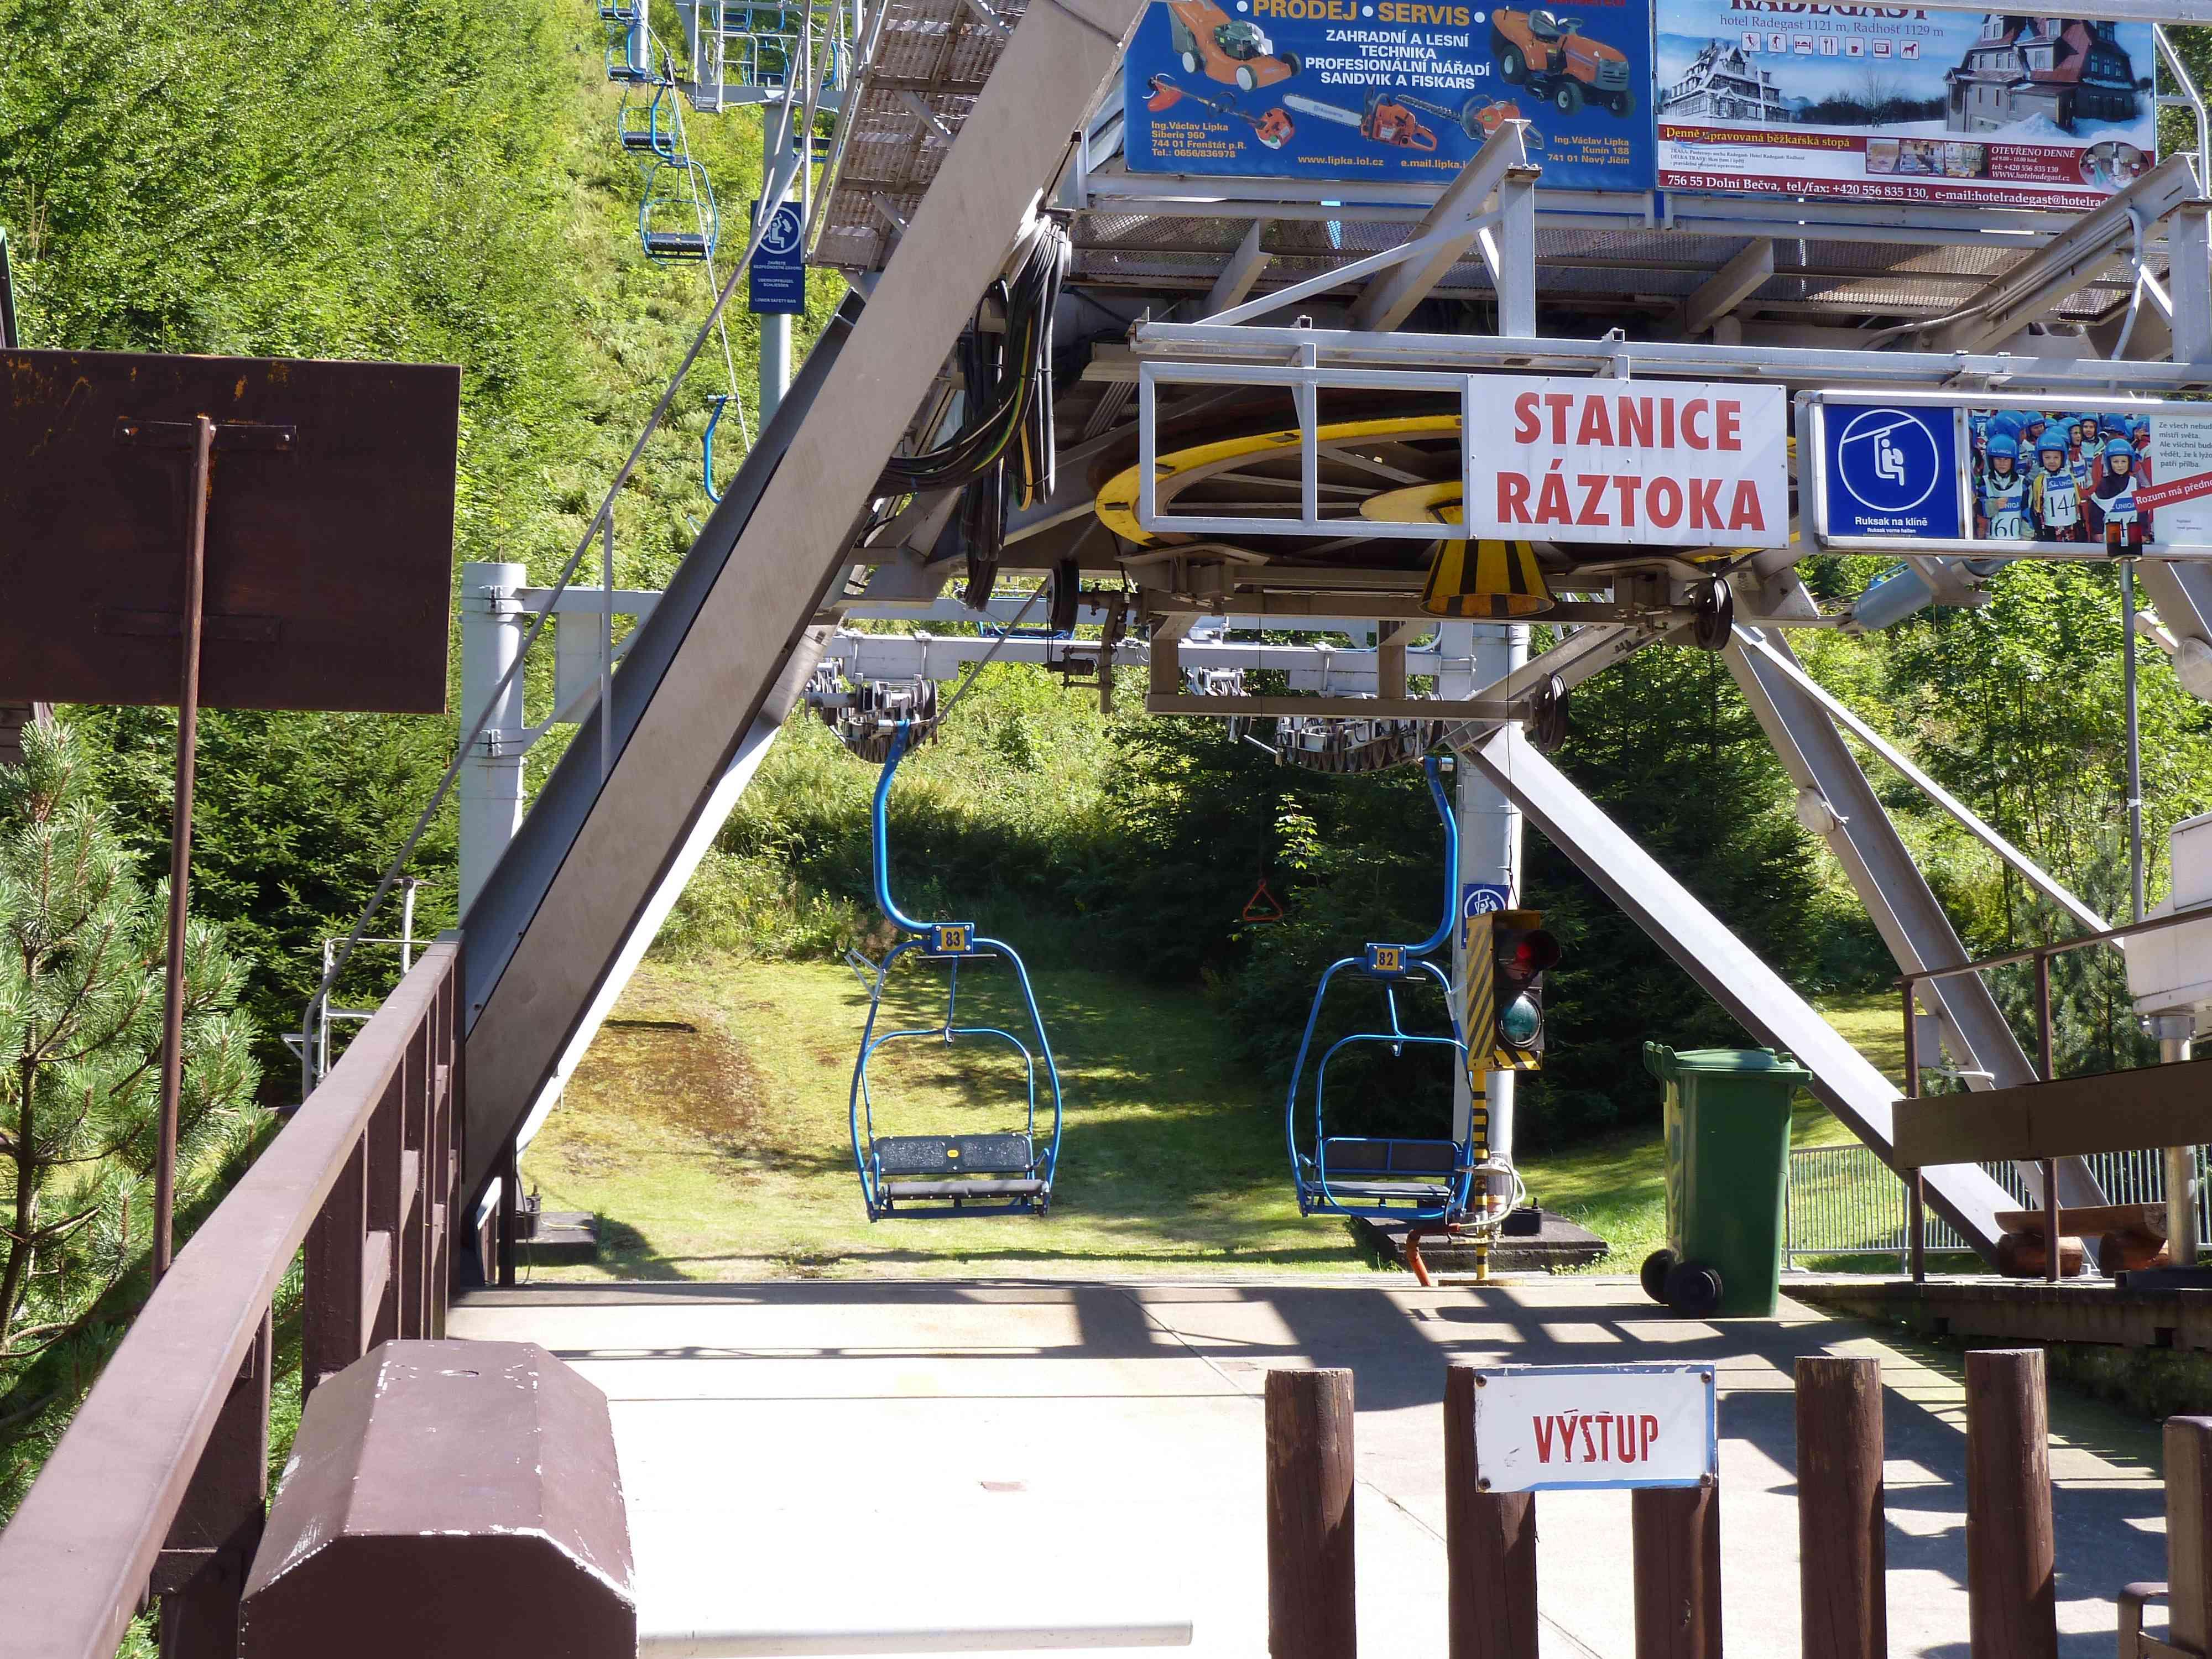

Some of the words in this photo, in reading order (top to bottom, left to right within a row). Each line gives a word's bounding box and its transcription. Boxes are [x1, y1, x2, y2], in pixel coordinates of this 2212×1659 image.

[1253, 0, 1357, 21] PRODEJ
[1378, 2, 1470, 26] SERVIS
[1720, 14, 1747, 27] hotel
[1752, 17, 1804, 30] Radegast
[1807, 19, 1831, 31] 1121
[1835, 24, 1850, 33] m,
[1854, 22, 1900, 35] Radhošť
[1905, 25, 1930, 36] 1129
[1933, 28, 1944, 36] m
[1326, 29, 1407, 44] ZAHRADNÍ
[1410, 34, 1422, 45] A
[1426, 33, 1469, 47] LESNÍ
[1359, 45, 1437, 59] TECHNIKA
[1305, 57, 1427, 73] PROFESIONÁLNÍ
[1431, 61, 1490, 76] NÁŘADÍ
[1321, 72, 1391, 86] SANDVIK
[1395, 75, 1407, 86] A
[1411, 75, 1475, 90] FISKARS
[1151, 121, 1200, 131] Ing.Václav
[1203, 122, 1229, 132] Lipka
[1554, 135, 1601, 144] Ing.Václav
[1604, 137, 1629, 147] Lipka
[1666, 127, 1700, 138] Denně
[1767, 132, 1819, 145] běžkařská
[1822, 137, 1850, 148] stopá
[1582, 145, 1609, 154] Kunín
[1991, 146, 2042, 156] OTEVŘENO
[2043, 149, 2075, 158] DENNĚ
[1401, 159, 1468, 169] e.mail.lipka.i
[1581, 155, 1605, 165] Nový
[1607, 155, 1629, 164] Jičín
[1667, 175, 1687, 186] 756
[1689, 176, 1703, 186] 55
[1706, 176, 1740, 189] Dolní
[1744, 179, 1781, 192] Bečva,
[1787, 181, 1830, 194] tel./fax:
[1832, 184, 1860, 195] +420
[1862, 185, 1882, 196] 556
[1884, 186, 1904, 197] 835
[1907, 187, 1929, 200] 130,
[1514, 392, 1742, 452] STANICE
[1496, 458, 1766, 531] RÁZTOKA
[2135, 491, 2166, 505] Rozum
[2168, 486, 2183, 497] má
[1855, 516, 1890, 525] Ruksak
[1906, 517, 1928, 526] klíně
[946, 931, 961, 947] 83
[1379, 952, 1394, 966] 82
[1532, 1409, 1659, 1463] VÝSTUP
